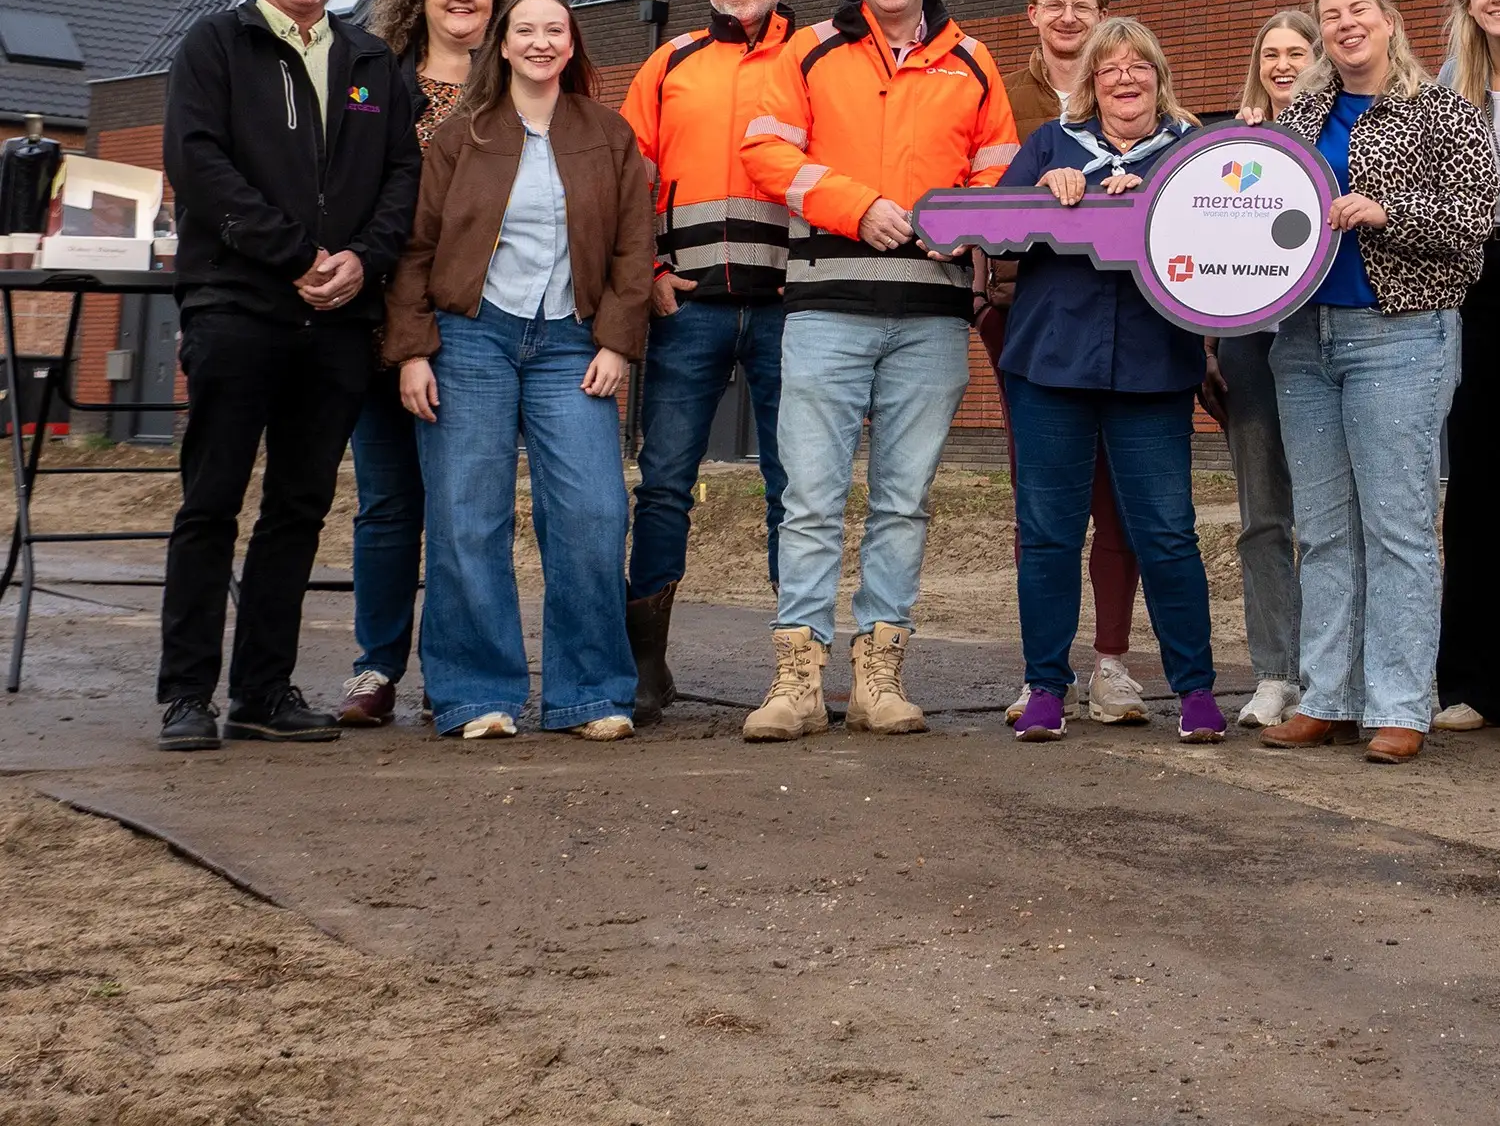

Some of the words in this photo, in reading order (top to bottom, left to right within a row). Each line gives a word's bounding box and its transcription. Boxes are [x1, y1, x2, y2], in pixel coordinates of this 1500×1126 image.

[1192, 195, 1284, 209] mercatus
[1230, 211, 1240, 219] op
[1254, 210, 1270, 218] best
[1198, 263, 1227, 275] VAN
[1232, 264, 1289, 276] WIJNEN
